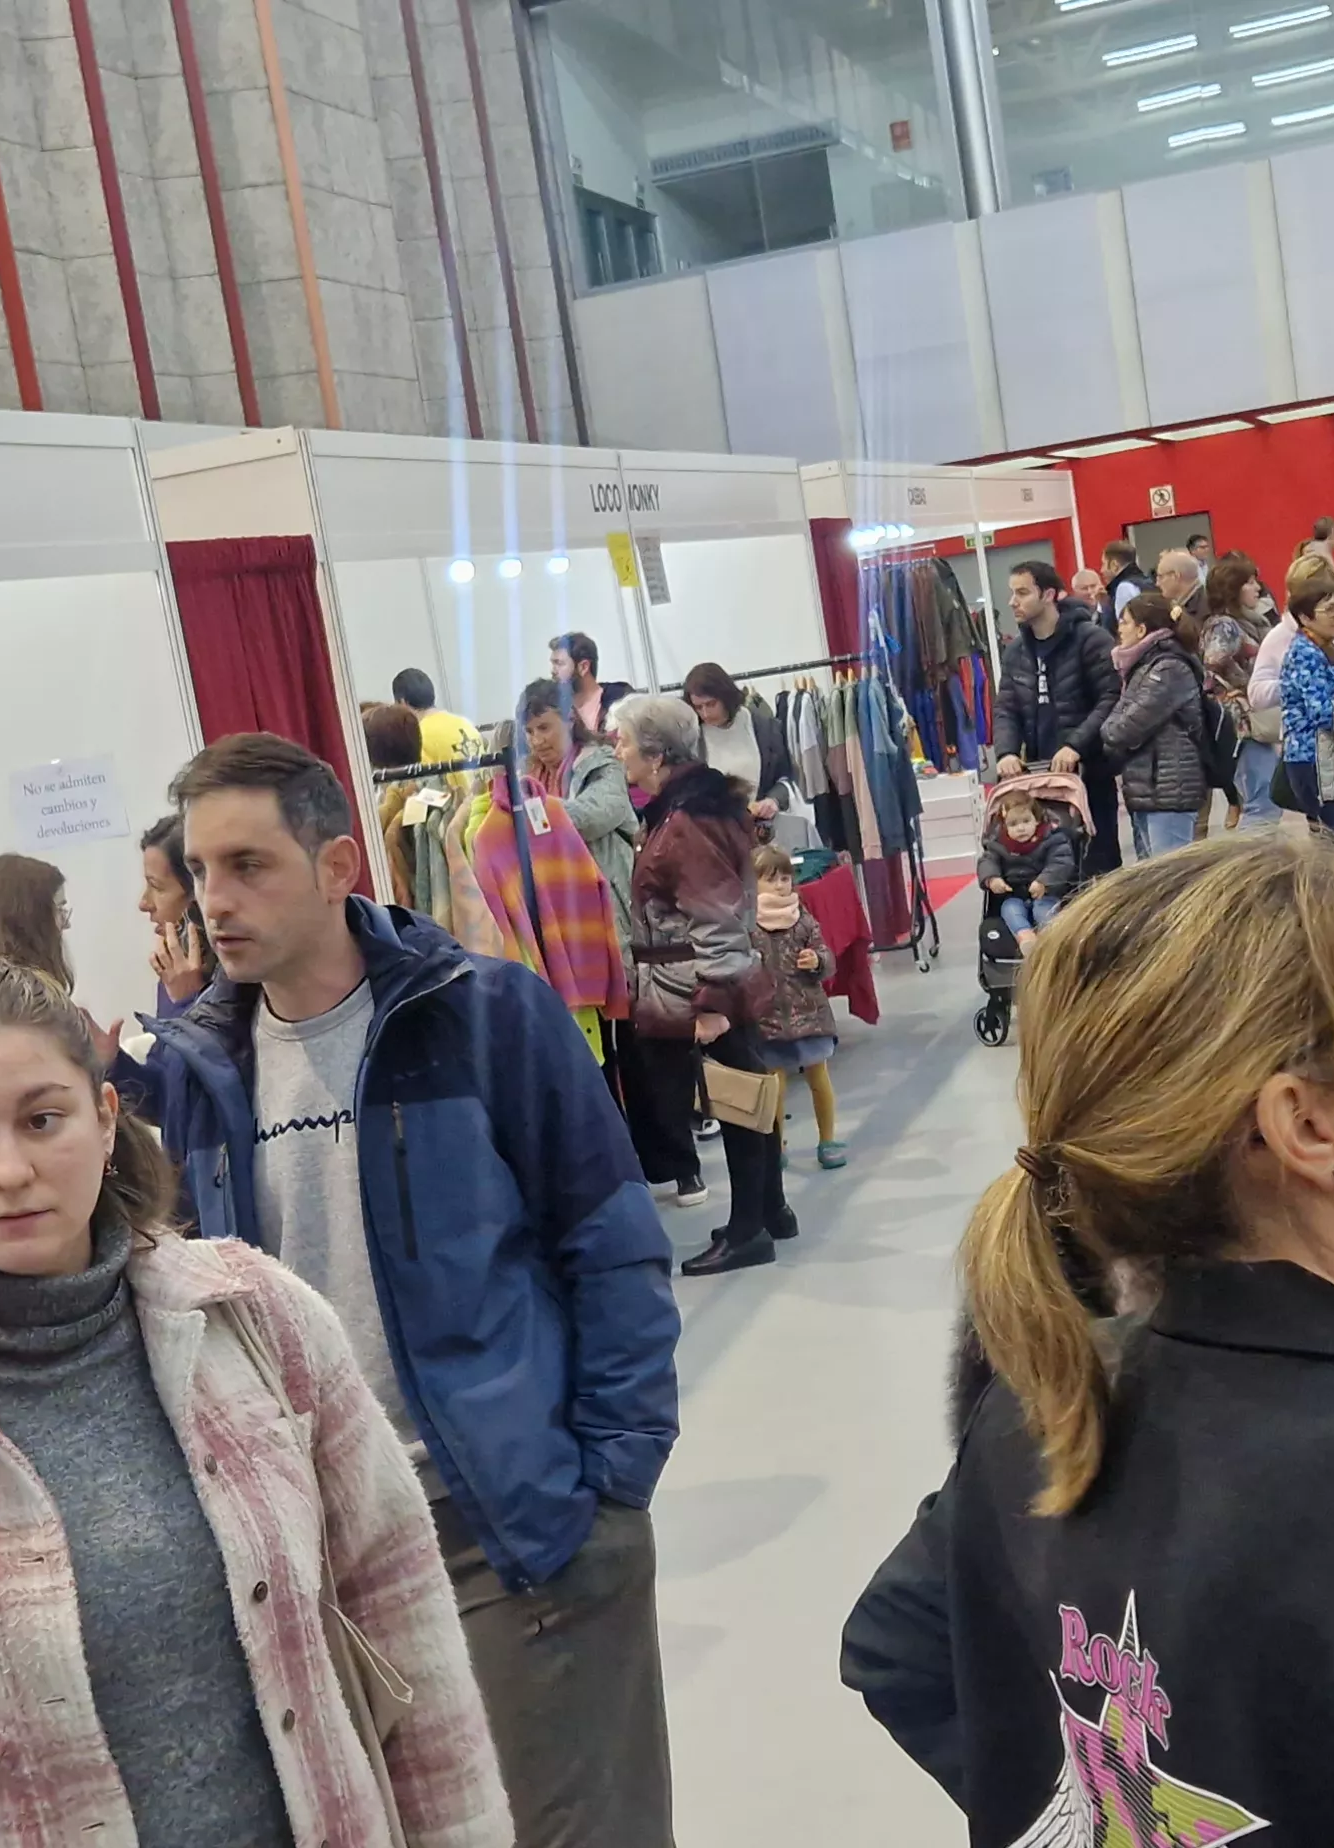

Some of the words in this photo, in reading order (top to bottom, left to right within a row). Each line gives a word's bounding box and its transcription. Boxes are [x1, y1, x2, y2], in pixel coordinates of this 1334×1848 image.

[589, 483, 623, 513] LOCO
[23, 782, 42, 797] No
[44, 783, 56, 793] se
[59, 774, 106, 792] admiten
[41, 798, 88, 816] cambios
[90, 797, 98, 812] y
[37, 819, 111, 839] devoluciones
